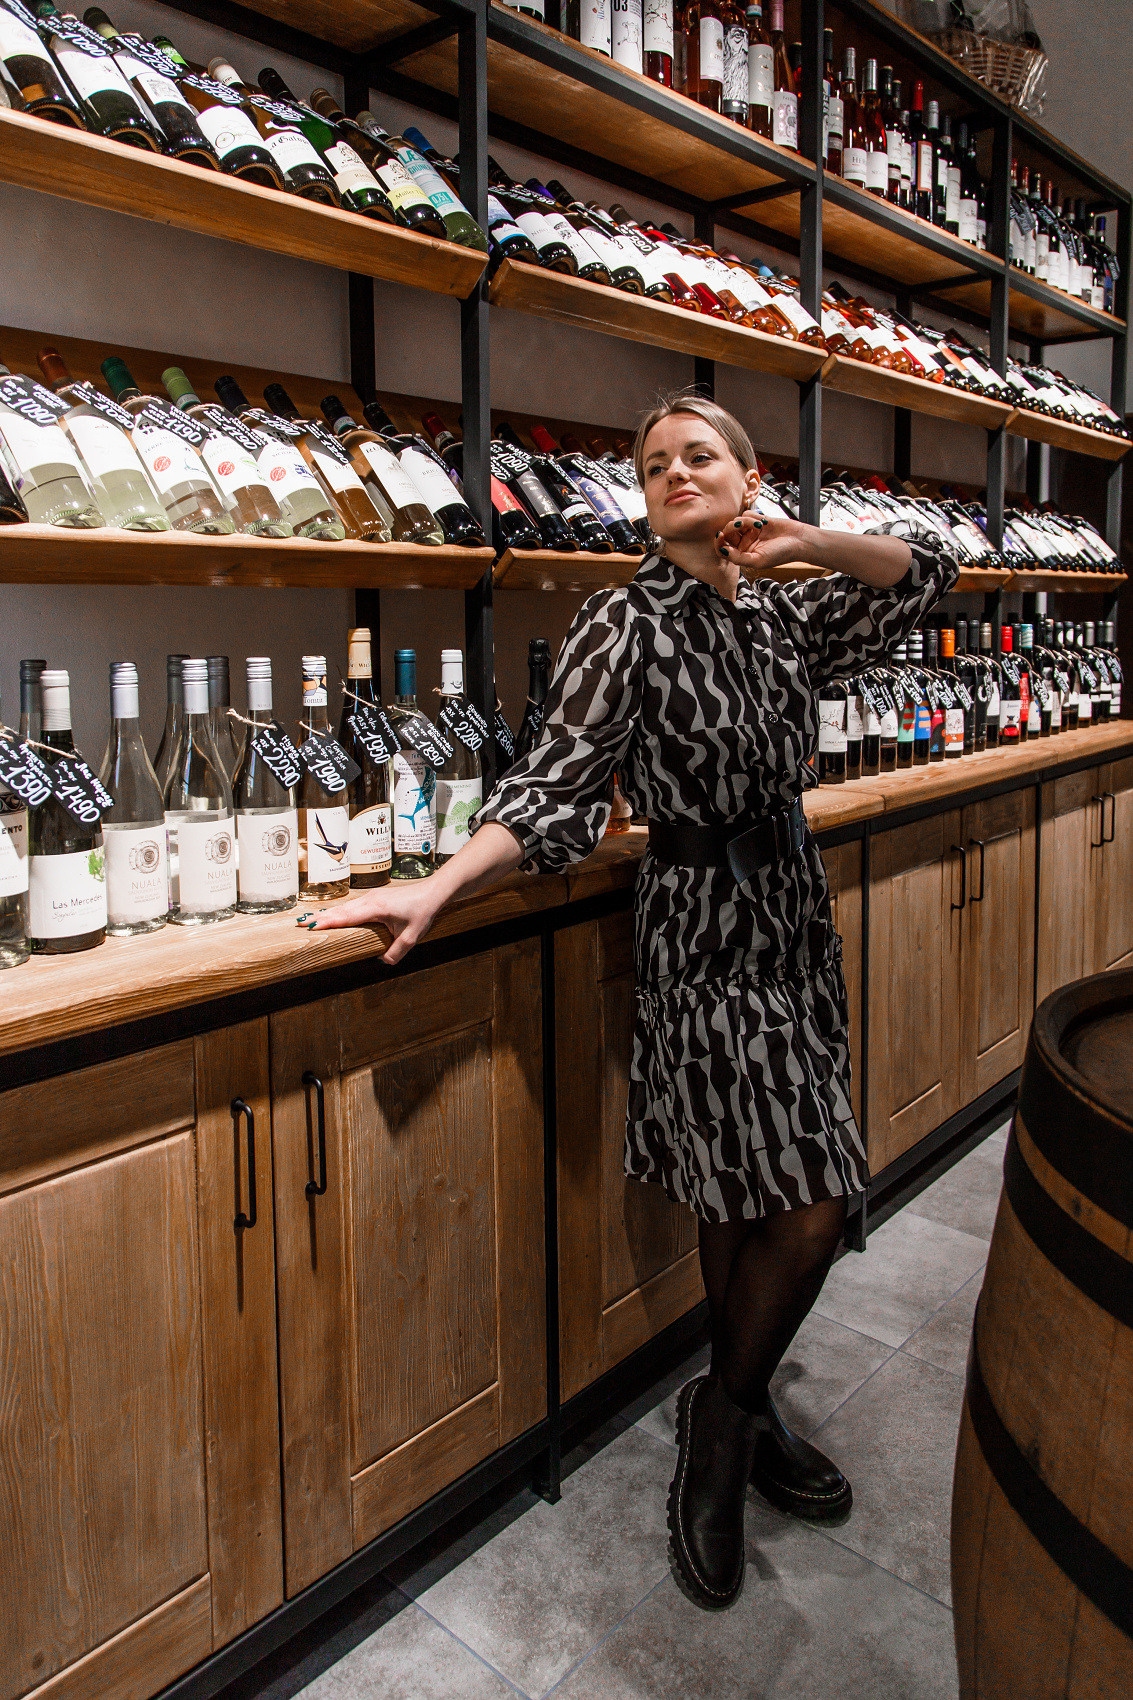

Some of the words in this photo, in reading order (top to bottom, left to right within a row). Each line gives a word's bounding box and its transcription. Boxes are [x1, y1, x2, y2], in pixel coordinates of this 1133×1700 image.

[264, 861, 293, 872] NUALA
[131, 877, 162, 890] NUALA
[52, 900, 68, 910] Las
